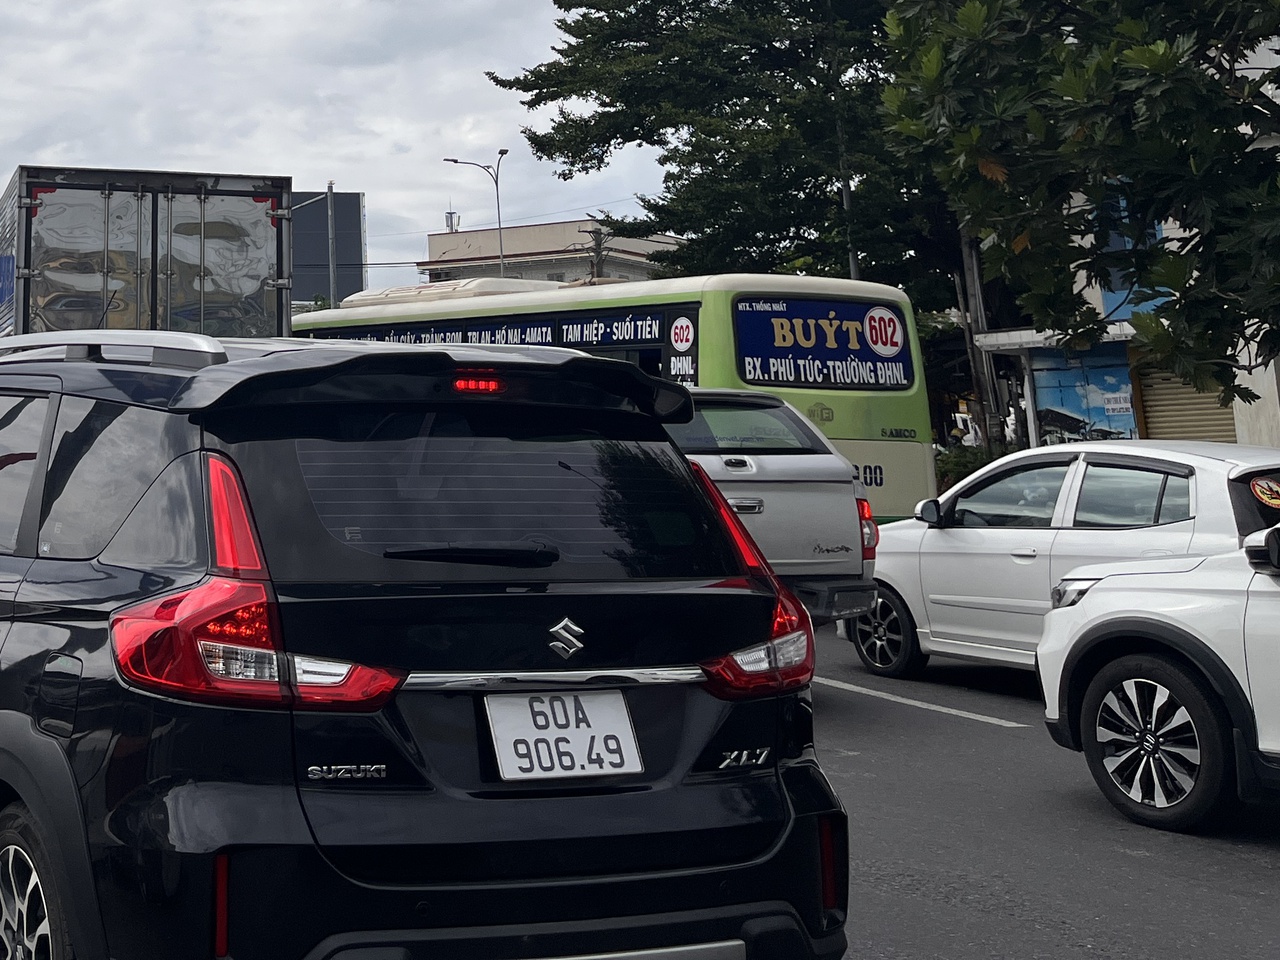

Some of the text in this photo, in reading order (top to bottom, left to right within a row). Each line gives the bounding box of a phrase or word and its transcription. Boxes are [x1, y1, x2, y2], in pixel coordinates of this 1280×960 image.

[562, 324, 581, 343] TAM
[583, 319, 605, 344] HIỆP
[612, 313, 634, 340] SUỐI
[636, 316, 659, 339] TIÊN
[673, 324, 690, 344] 602
[771, 310, 862, 350] BUÝT
[868, 315, 899, 347] 602
[670, 356, 694, 375] ĐHNL
[770, 354, 794, 382] PHÚ
[876, 361, 908, 385] ĐHNL
[881, 428, 917, 439] SAMCO
[531, 695, 592, 730] 60A
[513, 734, 626, 773] 906.49
[718, 746, 771, 768] XL7
[307, 764, 387, 780] SUZUKI
